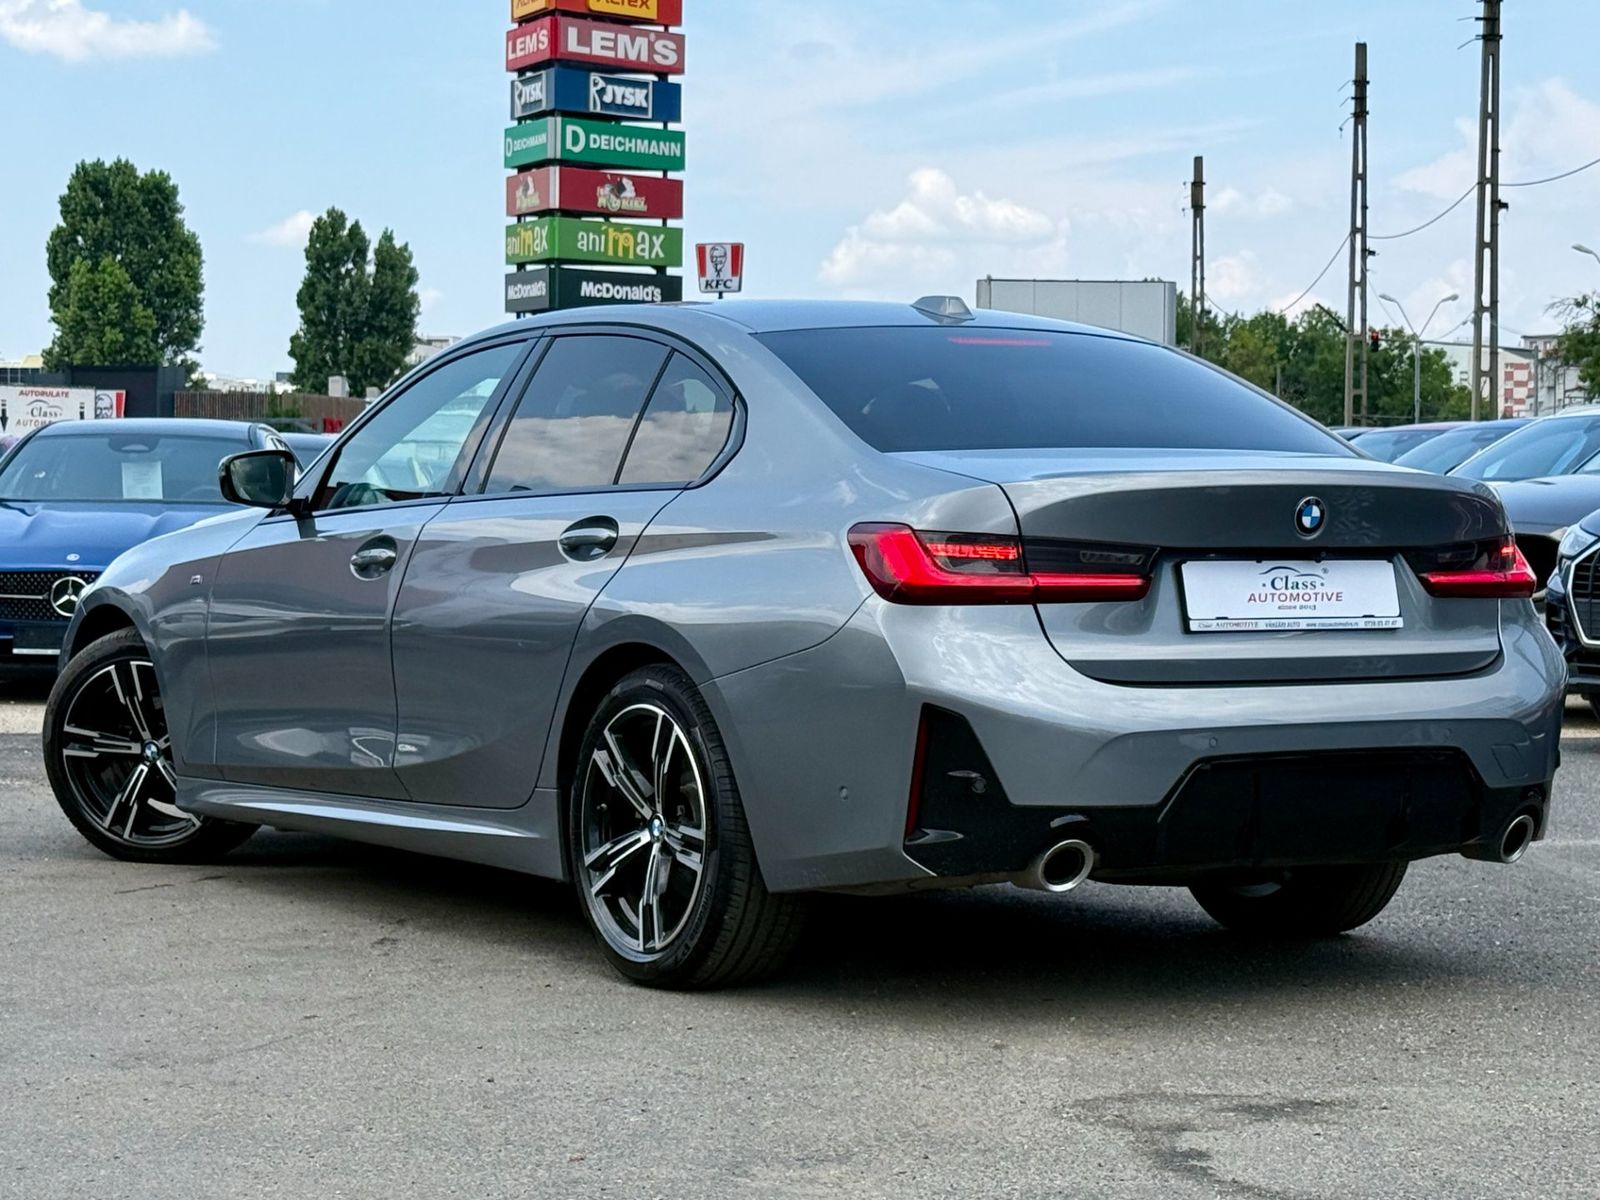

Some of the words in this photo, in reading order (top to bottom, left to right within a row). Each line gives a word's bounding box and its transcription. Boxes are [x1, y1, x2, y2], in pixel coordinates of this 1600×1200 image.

[507, 28, 549, 60] LEM'S
[567, 26, 678, 66] LEM'S
[521, 82, 543, 105] JYSK
[602, 86, 648, 108] JYSK
[513, 132, 548, 151] DEICHMANN
[589, 134, 681, 157] DEICHMANN
[507, 280, 547, 300] McDonald's
[580, 281, 662, 303] McDonald's
[704, 278, 733, 290] KFC
[30, 406, 58, 418] Class
[1270, 575, 1317, 591] Class
[1247, 592, 1344, 603] AUTOMOTIVE
